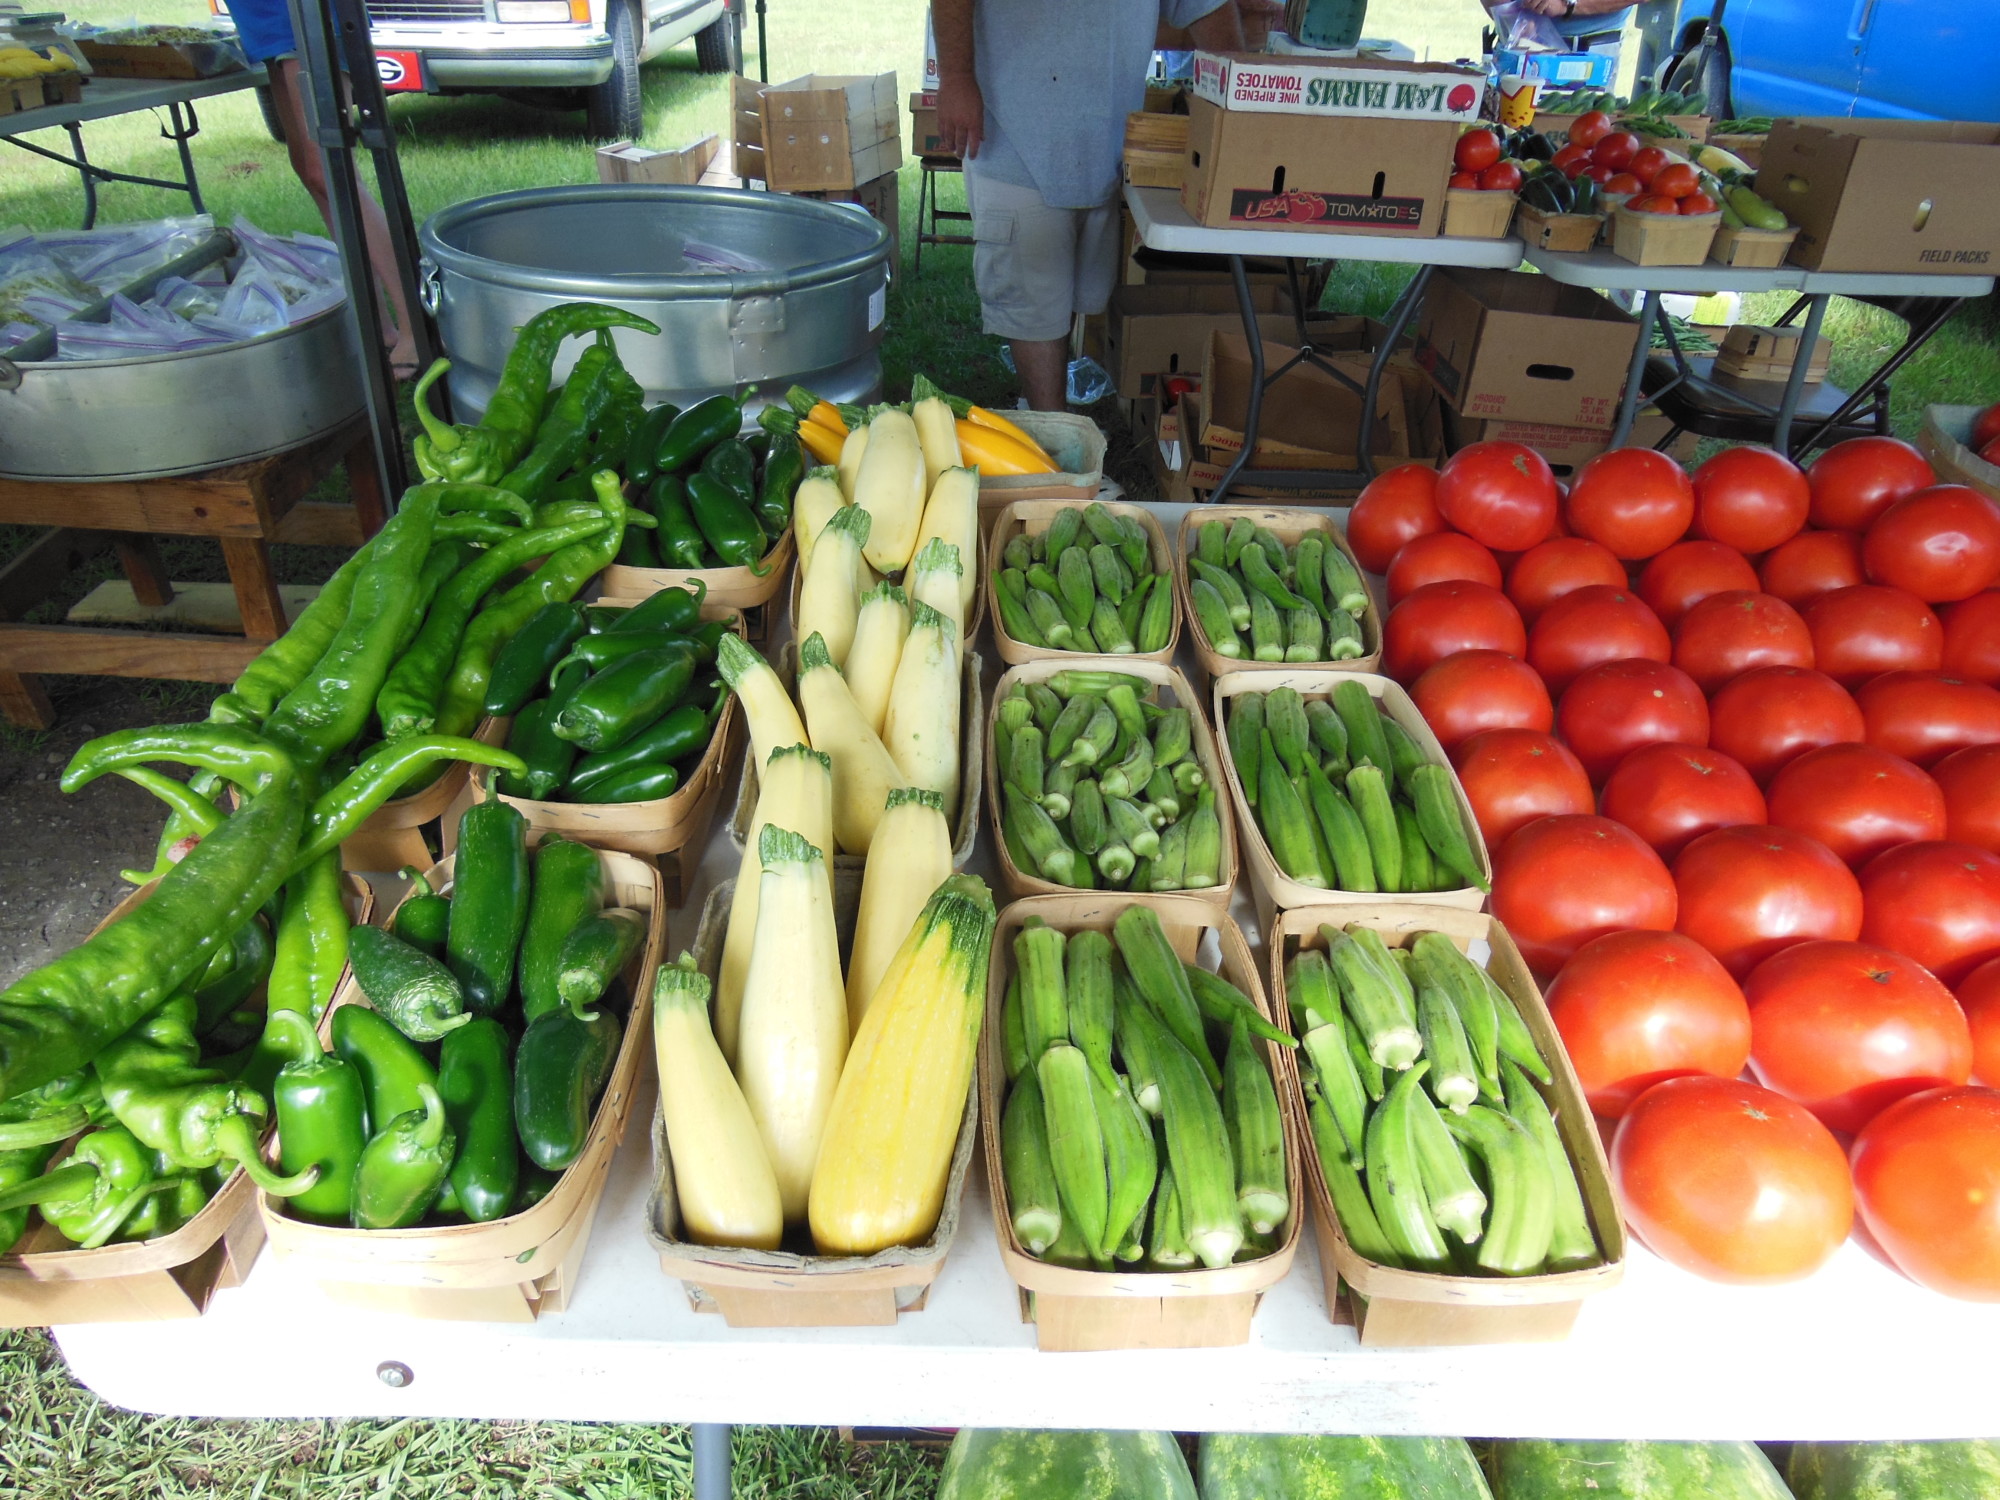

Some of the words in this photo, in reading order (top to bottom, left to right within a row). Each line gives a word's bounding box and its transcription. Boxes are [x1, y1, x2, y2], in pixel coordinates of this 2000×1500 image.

[1236, 73, 1302, 91] TOMATOES
[1234, 89, 1276, 103] RIPENED
[1278, 91, 1300, 104] VINE
[1305, 77, 1392, 107] FARMS
[1392, 81, 1448, 112] L&M
[1245, 197, 1291, 220] USA
[1918, 249, 1952, 263] FIELD
[1952, 250, 1991, 264] PACKS
[1474, 393, 1507, 405] PRODUCE
[1581, 397, 1595, 406] NET
[1471, 403, 1482, 412] OF
[1580, 405, 1589, 414] 25
[1595, 416, 1606, 425] KG
